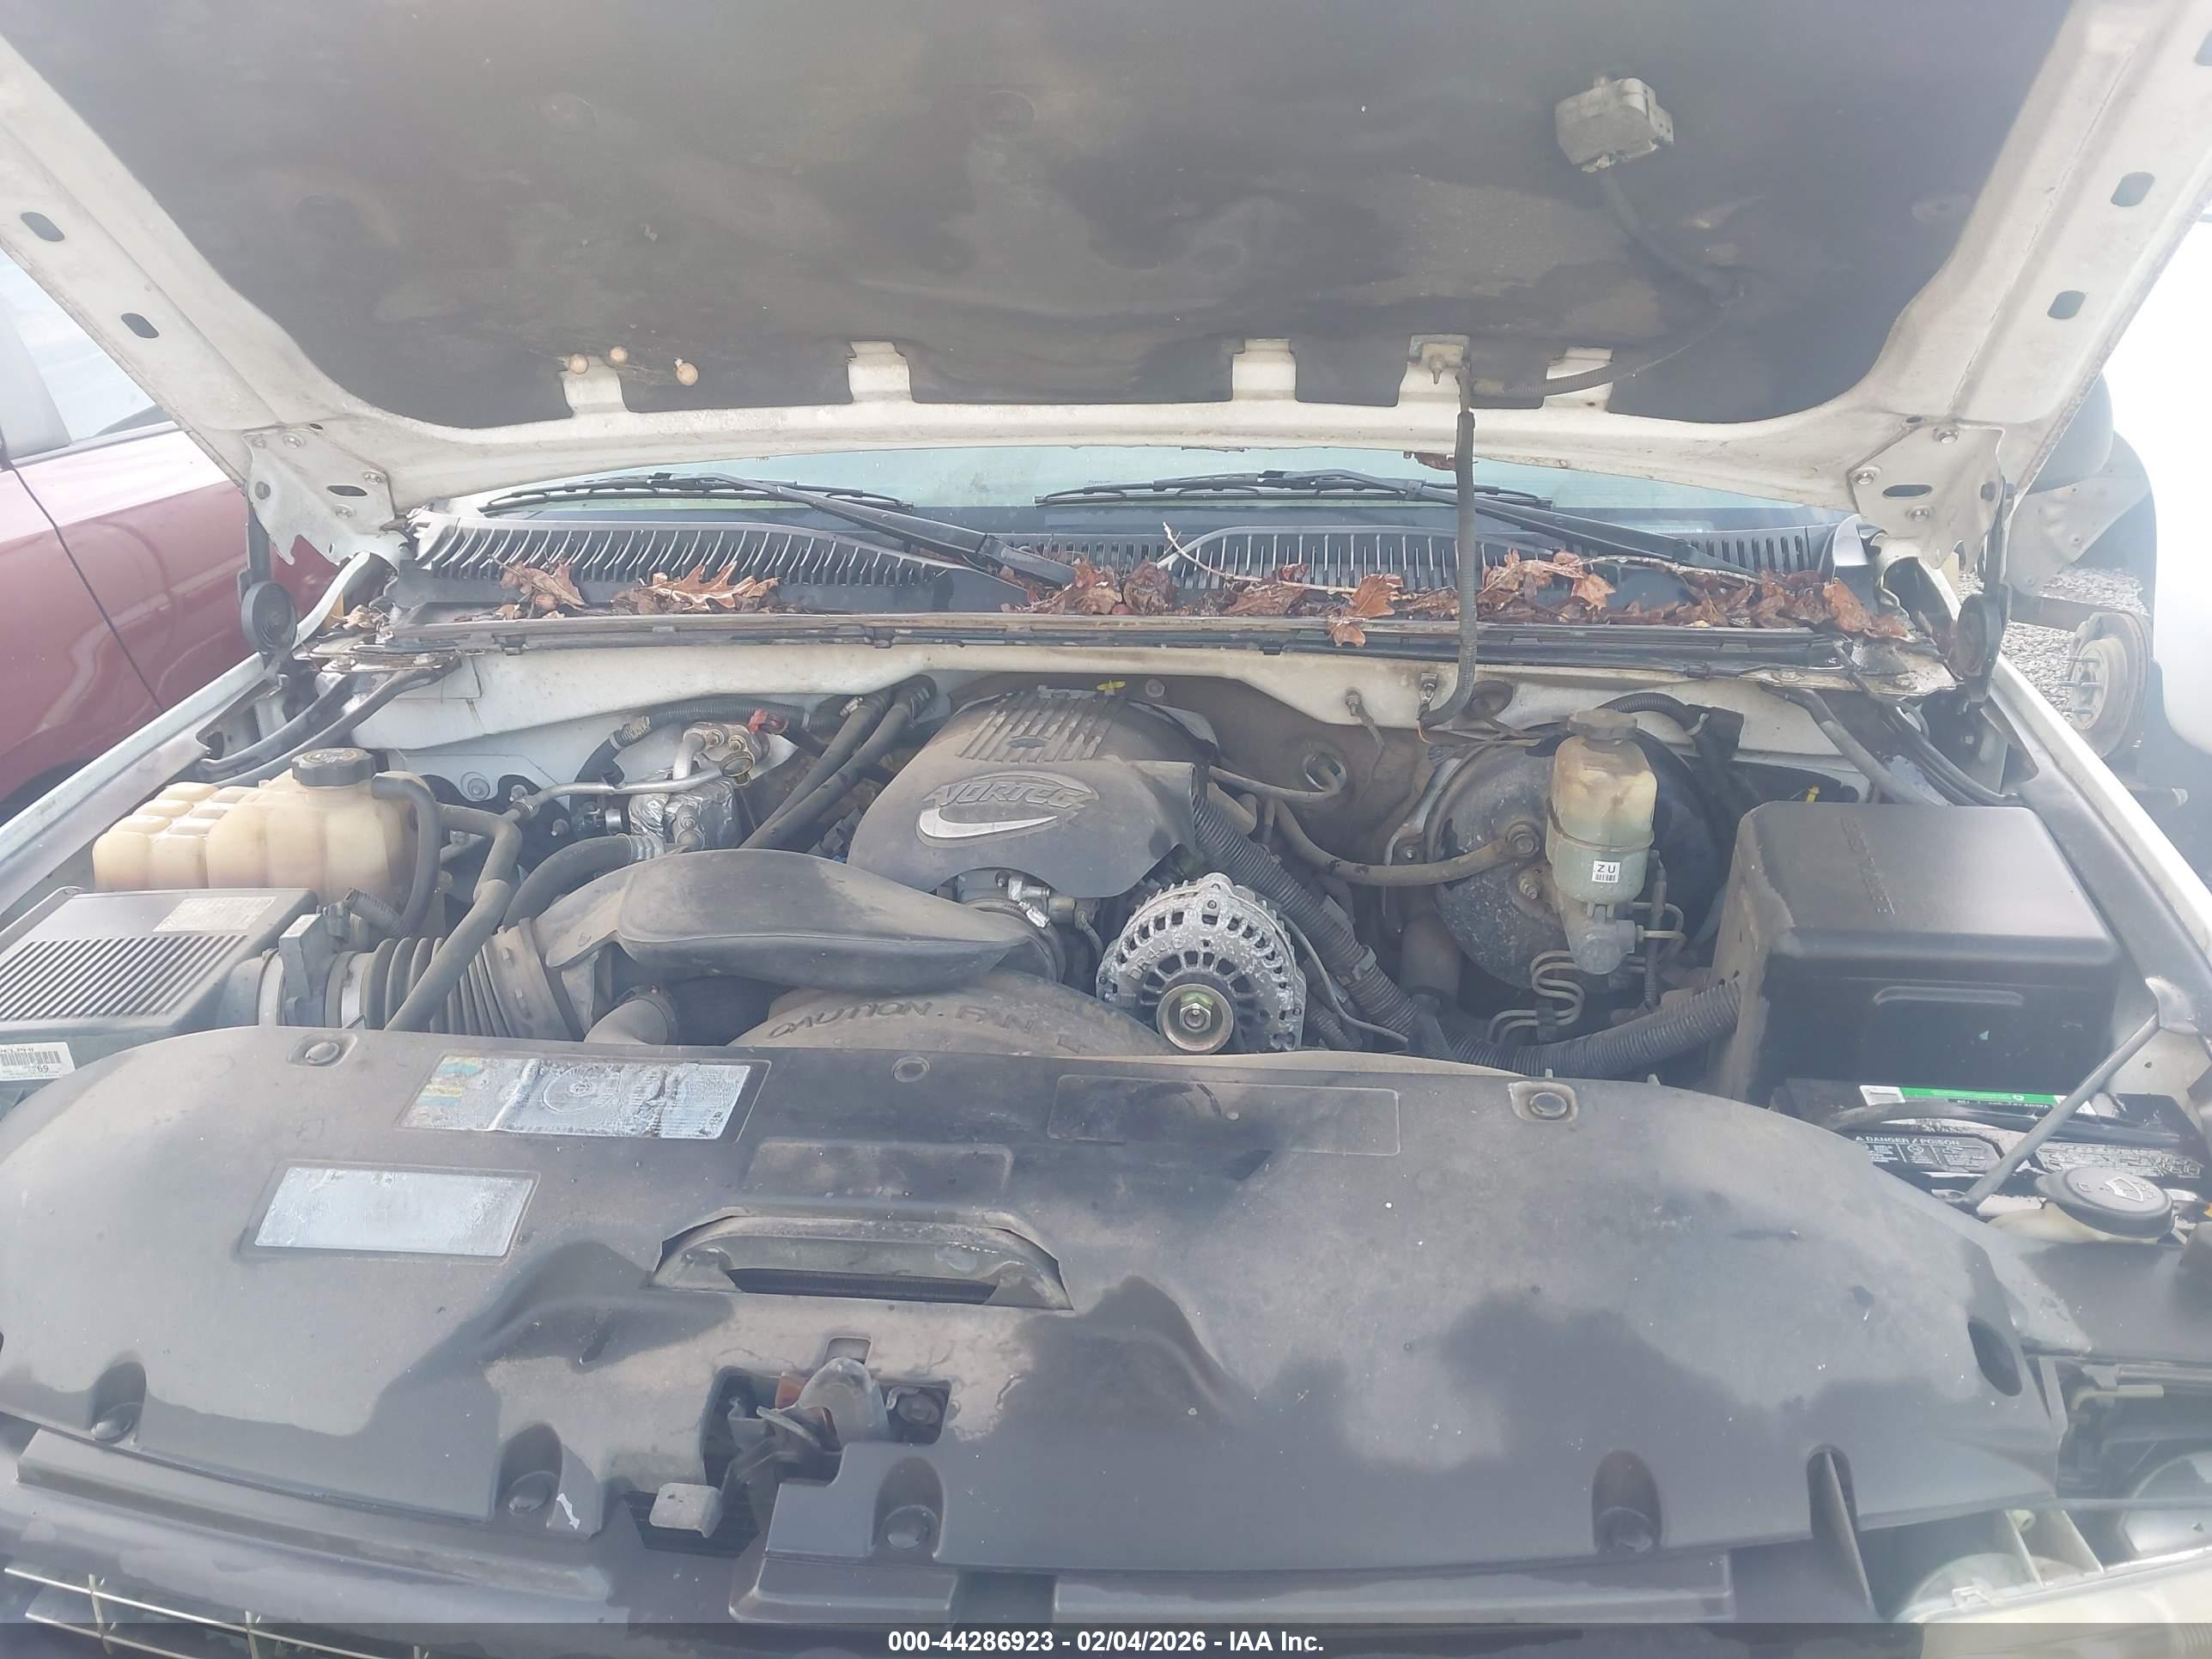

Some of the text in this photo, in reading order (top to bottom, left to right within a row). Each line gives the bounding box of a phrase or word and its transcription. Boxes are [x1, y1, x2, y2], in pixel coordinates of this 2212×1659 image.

[923, 781, 1088, 810] VORTEC
[769, 1000, 933, 1039] CAUTION
[1865, 1135, 1910, 1145] DANGER
[1920, 1138, 1960, 1146] POISON
